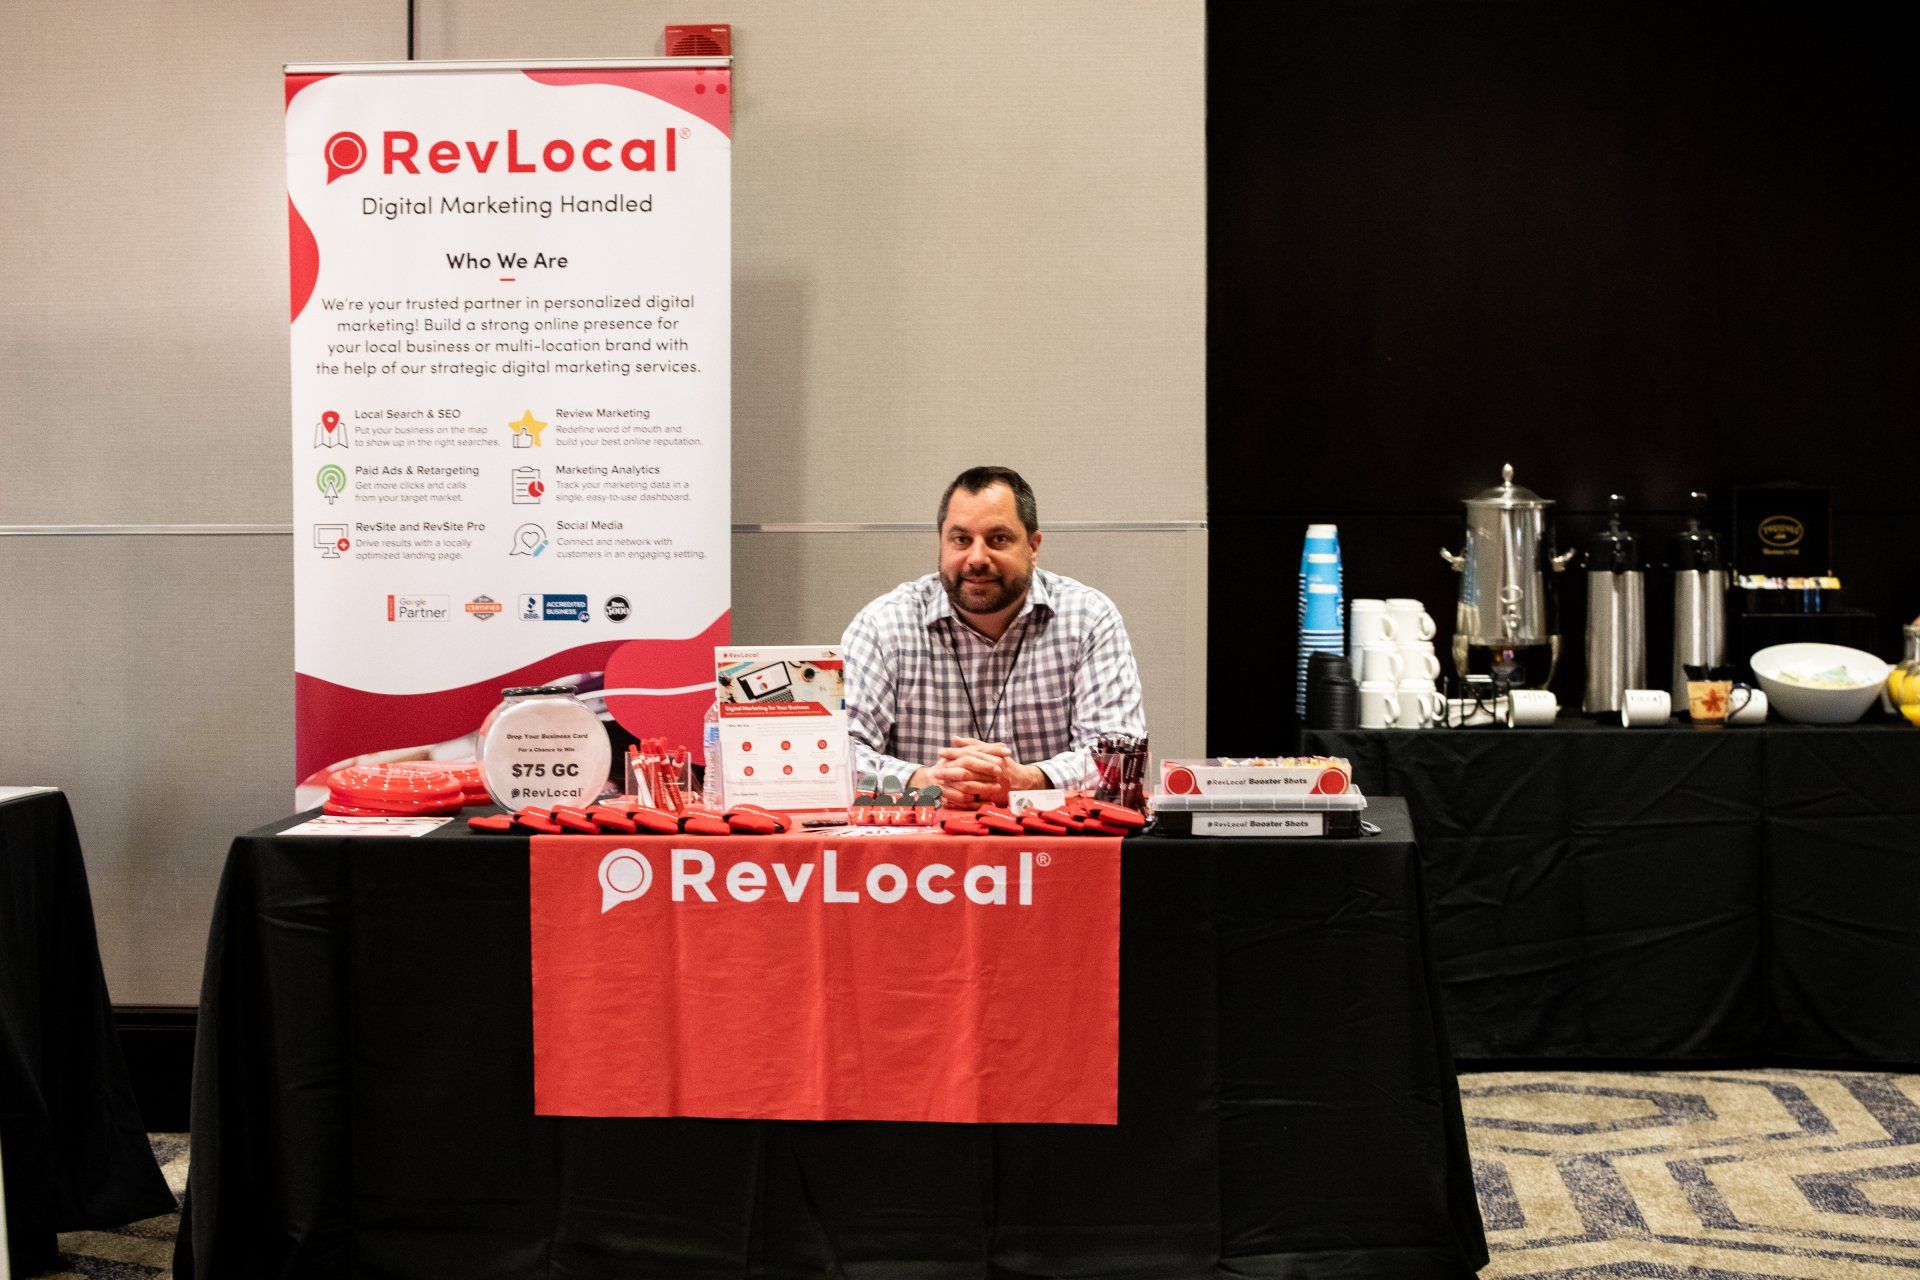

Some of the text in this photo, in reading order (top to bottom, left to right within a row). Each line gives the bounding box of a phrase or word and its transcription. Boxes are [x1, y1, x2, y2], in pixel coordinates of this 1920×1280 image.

[362, 193, 651, 220] Digital Marketing Handled
[446, 252, 567, 268] Who We Are
[321, 294, 693, 313] We're your trusted partner in personalized digital
[337, 316, 679, 335] marketing! Build a strong online presence for
[327, 337, 688, 356] your local business or multi-location brand with
[316, 359, 700, 377] the help of our strategic digital marketing services.
[354, 408, 461, 418] Local Search & SEO
[555, 408, 650, 419] Review Marketing
[354, 426, 370, 434] Put
[371, 427, 392, 435] your
[394, 425, 434, 434] business
[467, 427, 488, 435] map
[556, 424, 682, 433] Redefine word of mouth and
[365, 438, 390, 446] show
[392, 439, 405, 447] up
[406, 438, 415, 446] in
[417, 438, 432, 446] the
[434, 438, 455, 448] right
[555, 437, 577, 446] build
[579, 438, 598, 447] your
[622, 437, 650, 445] online
[355, 465, 479, 476] Paid Ads & Retargeting
[555, 464, 660, 476] Marketing Analytics
[354, 481, 371, 489] Get
[399, 480, 424, 489] clicks
[426, 481, 444, 489] and
[446, 481, 467, 489] calls
[555, 480, 579, 489] Track
[581, 482, 600, 490] your
[602, 480, 647, 490] marketing
[649, 480, 670, 488] data
[672, 480, 682, 488] in
[354, 493, 376, 501] from
[377, 495, 398, 503] your
[400, 494, 428, 503] target
[586, 493, 638, 502] easy-to-use
[355, 521, 485, 531] RevSite and RevSite Pro
[556, 520, 623, 529] Social Media
[355, 538, 380, 547] Drive
[381, 539, 412, 547] results
[413, 538, 433, 547] with
[442, 538, 471, 548] locally
[556, 537, 672, 545] Connect and network with
[355, 551, 400, 560] optimized
[401, 551, 435, 561] landing
[556, 550, 602, 558] customers
[627, 550, 671, 560] engaging
[399, 597, 427, 607] Google
[399, 606, 447, 618] Partner
[511, 763, 578, 778] $75 GC
[523, 788, 582, 798] RevLocal
